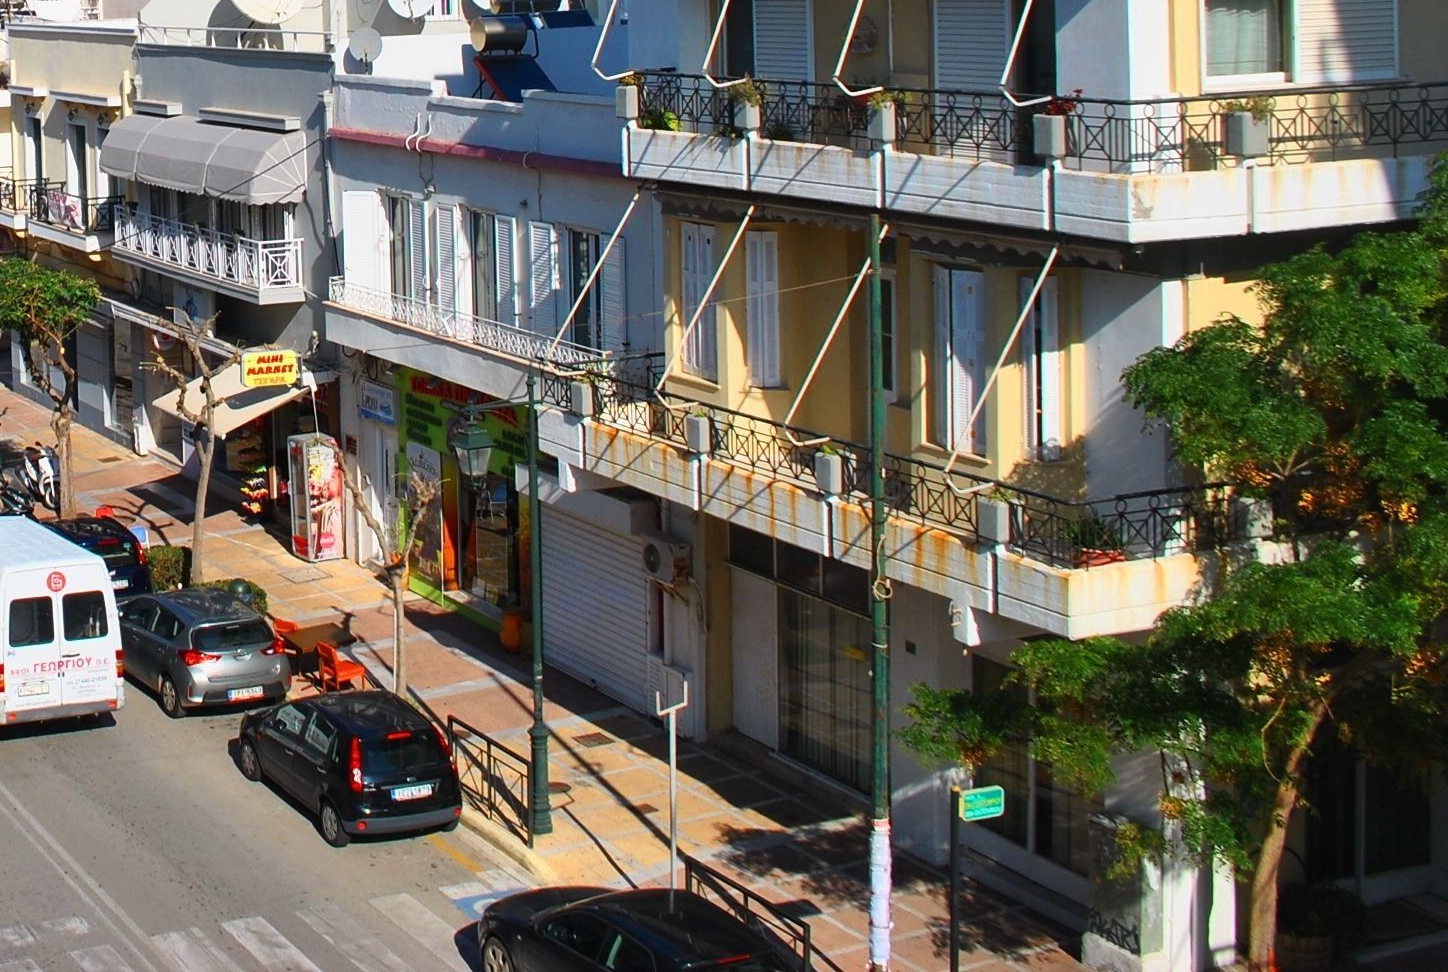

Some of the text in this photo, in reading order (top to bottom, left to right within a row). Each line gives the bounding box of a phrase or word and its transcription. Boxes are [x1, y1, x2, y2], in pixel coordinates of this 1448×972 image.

[256, 353, 284, 365] MINI
[246, 363, 294, 377] MARKET
[33, 657, 93, 673] ΓΕΩΡΓΙΟΥ
